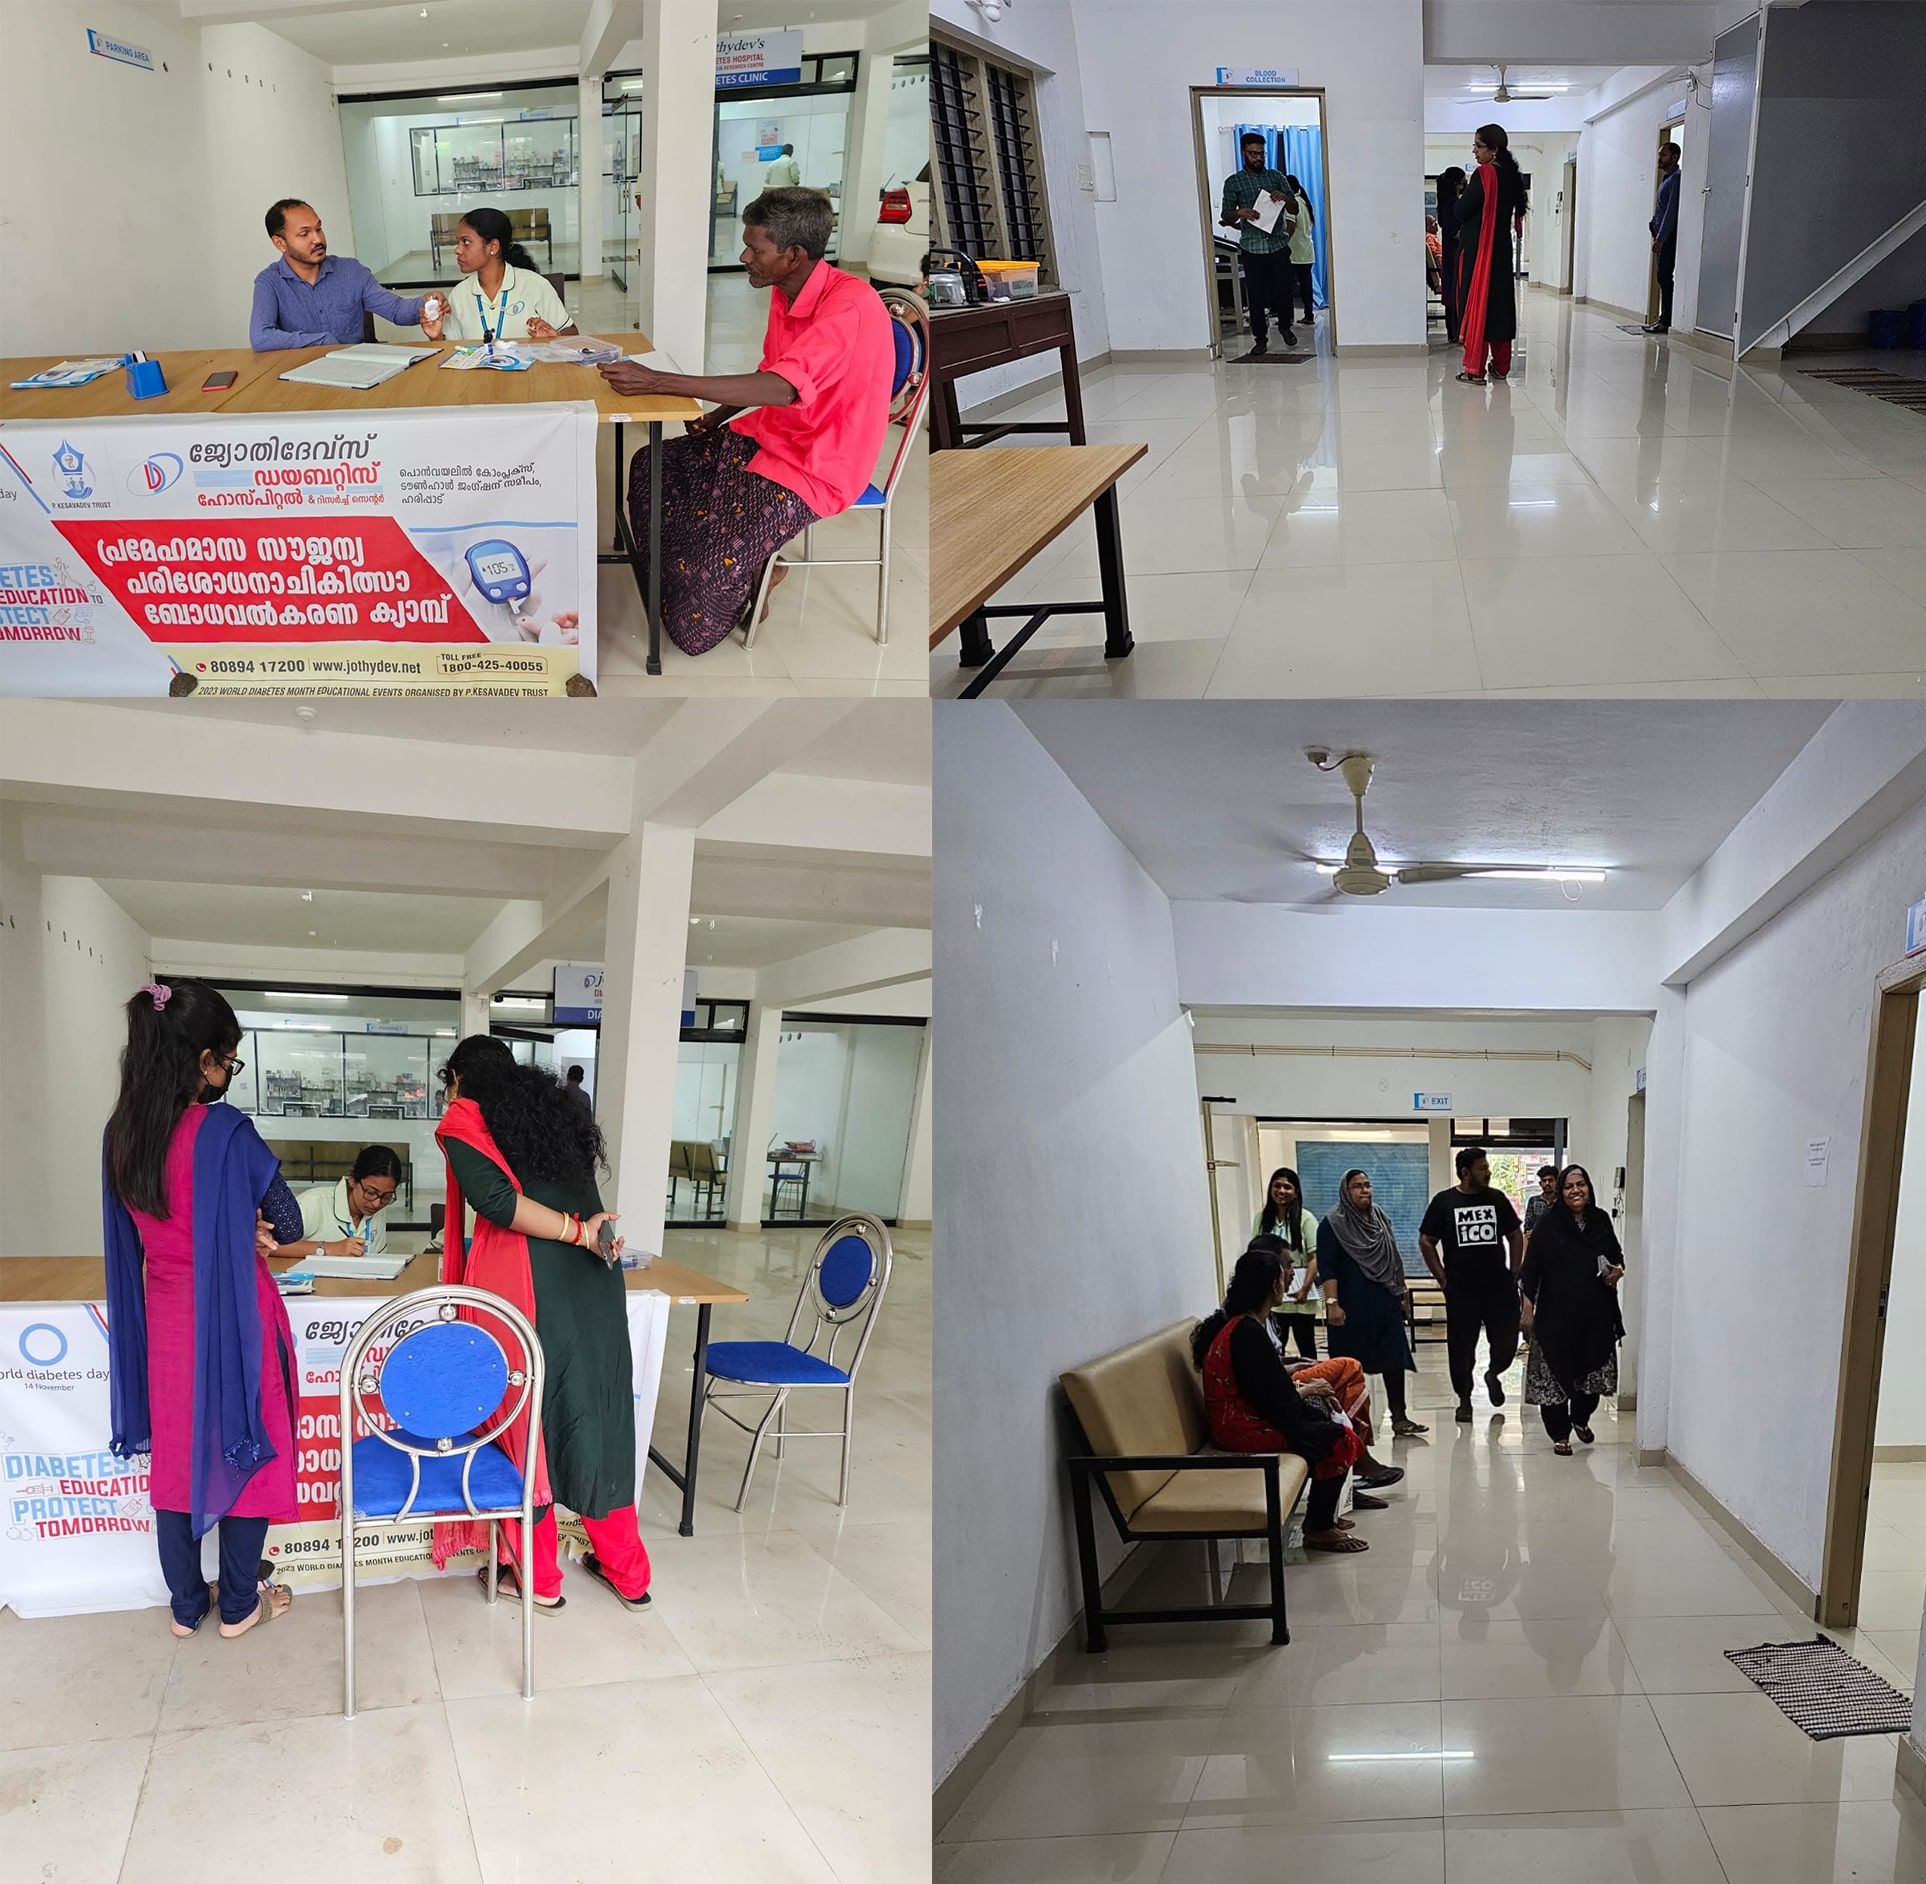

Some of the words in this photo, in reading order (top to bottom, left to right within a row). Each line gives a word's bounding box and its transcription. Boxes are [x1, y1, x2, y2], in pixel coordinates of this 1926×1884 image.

[105, 41, 134, 57] PARKING
[134, 50, 150, 62] AREA
[716, 38, 765, 55] thydev's
[716, 56, 731, 64] ETES
[732, 53, 765, 63] HOSPITAL
[716, 75, 737, 85] ETES
[738, 72, 769, 83] CLINIC
[254, 461, 381, 491] ഡയബറ്റിസ്
[308, 494, 315, 504] &
[96, 537, 247, 567] പ്രമേഹമാസ
[256, 536, 365, 567] സൗജന്യ
[487, 562, 509, 575] 105
[0, 565, 60, 588] ETES:
[90, 595, 104, 605] TO
[0, 606, 50, 624] TECT
[441, 653, 459, 661] TOLL
[462, 652, 482, 661] FREE
[210, 660, 255, 673] 80894
[259, 660, 305, 673] 17200
[312, 659, 421, 675] www.jothydev.net
[442, 660, 543, 673] 1800-425-40055
[199, 687, 218, 696] 2023
[219, 687, 248, 696] WORLD
[248, 687, 285, 696] DIABETES
[287, 687, 315, 697] MONTH
[317, 686, 370, 697] EDUCATIONAL
[373, 688, 403, 697] EVENTS
[405, 688, 451, 697] ORGANISED
[452, 689, 463, 697] BY
[522, 689, 549, 697] TRUST
[1431, 1097, 1449, 1105] EXIT
[1457, 1208, 1494, 1222] MEX
[0, 1368, 22, 1380] orld
[26, 1370, 83, 1381] diabetes
[86, 1368, 110, 1381] day
[35, 1383, 75, 1391] November
[60, 1475, 150, 1497] EDUCATIO
[13, 1497, 118, 1522] PROTECT
[35, 1517, 150, 1538] TOMORROW
[284, 1539, 330, 1554] 80894
[335, 1534, 380, 1550] 1200
[276, 1564, 295, 1575] 2023
[297, 1564, 325, 1572] WORLD
[365, 1557, 394, 1567] MONTH
